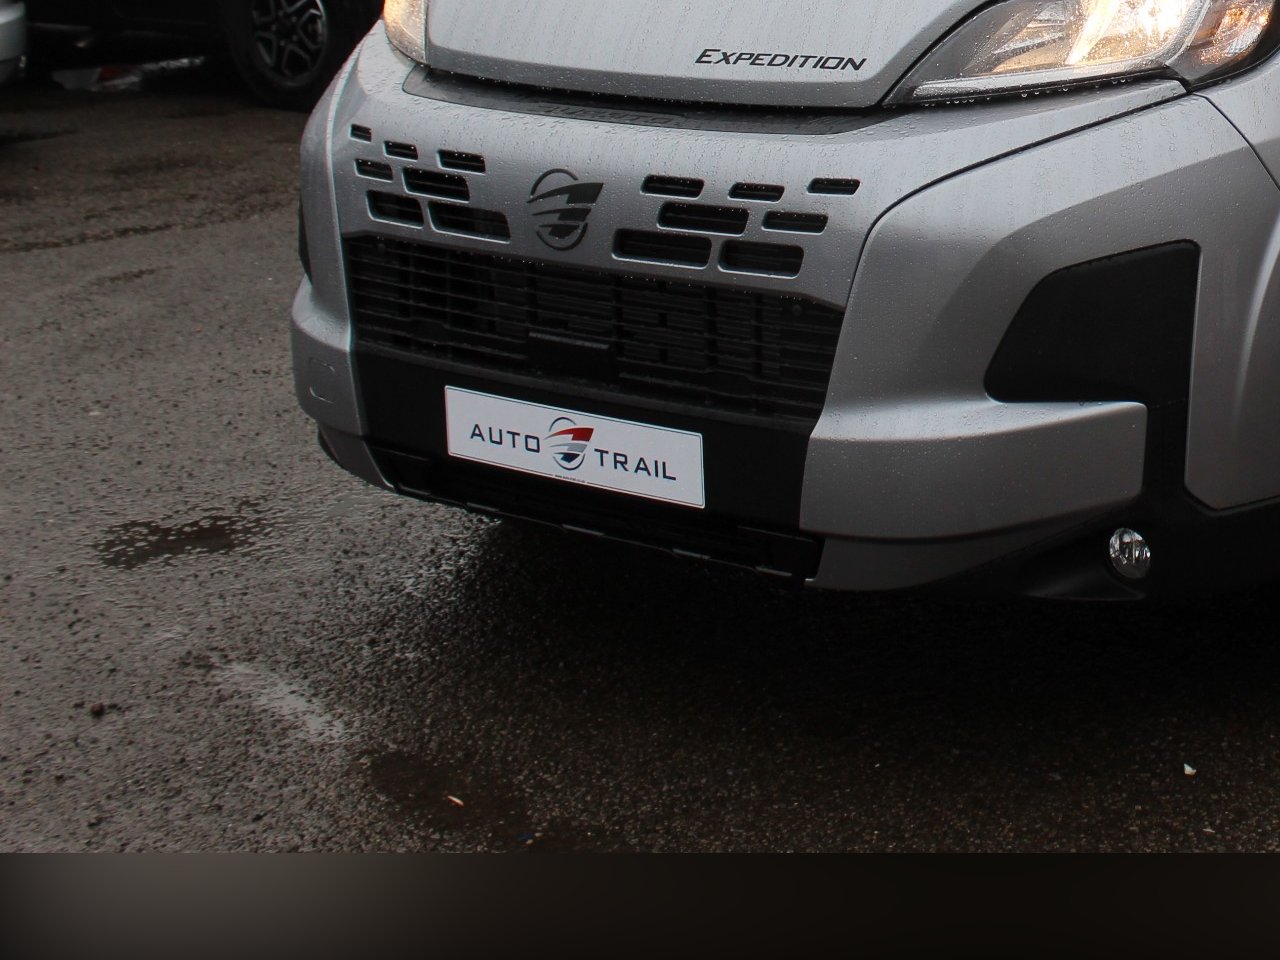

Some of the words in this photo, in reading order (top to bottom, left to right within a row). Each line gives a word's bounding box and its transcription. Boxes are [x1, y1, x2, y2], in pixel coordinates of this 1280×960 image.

[695, 48, 867, 71] EXPEDITION
[470, 423, 541, 454] AUTO
[594, 448, 677, 481] TRAIL
